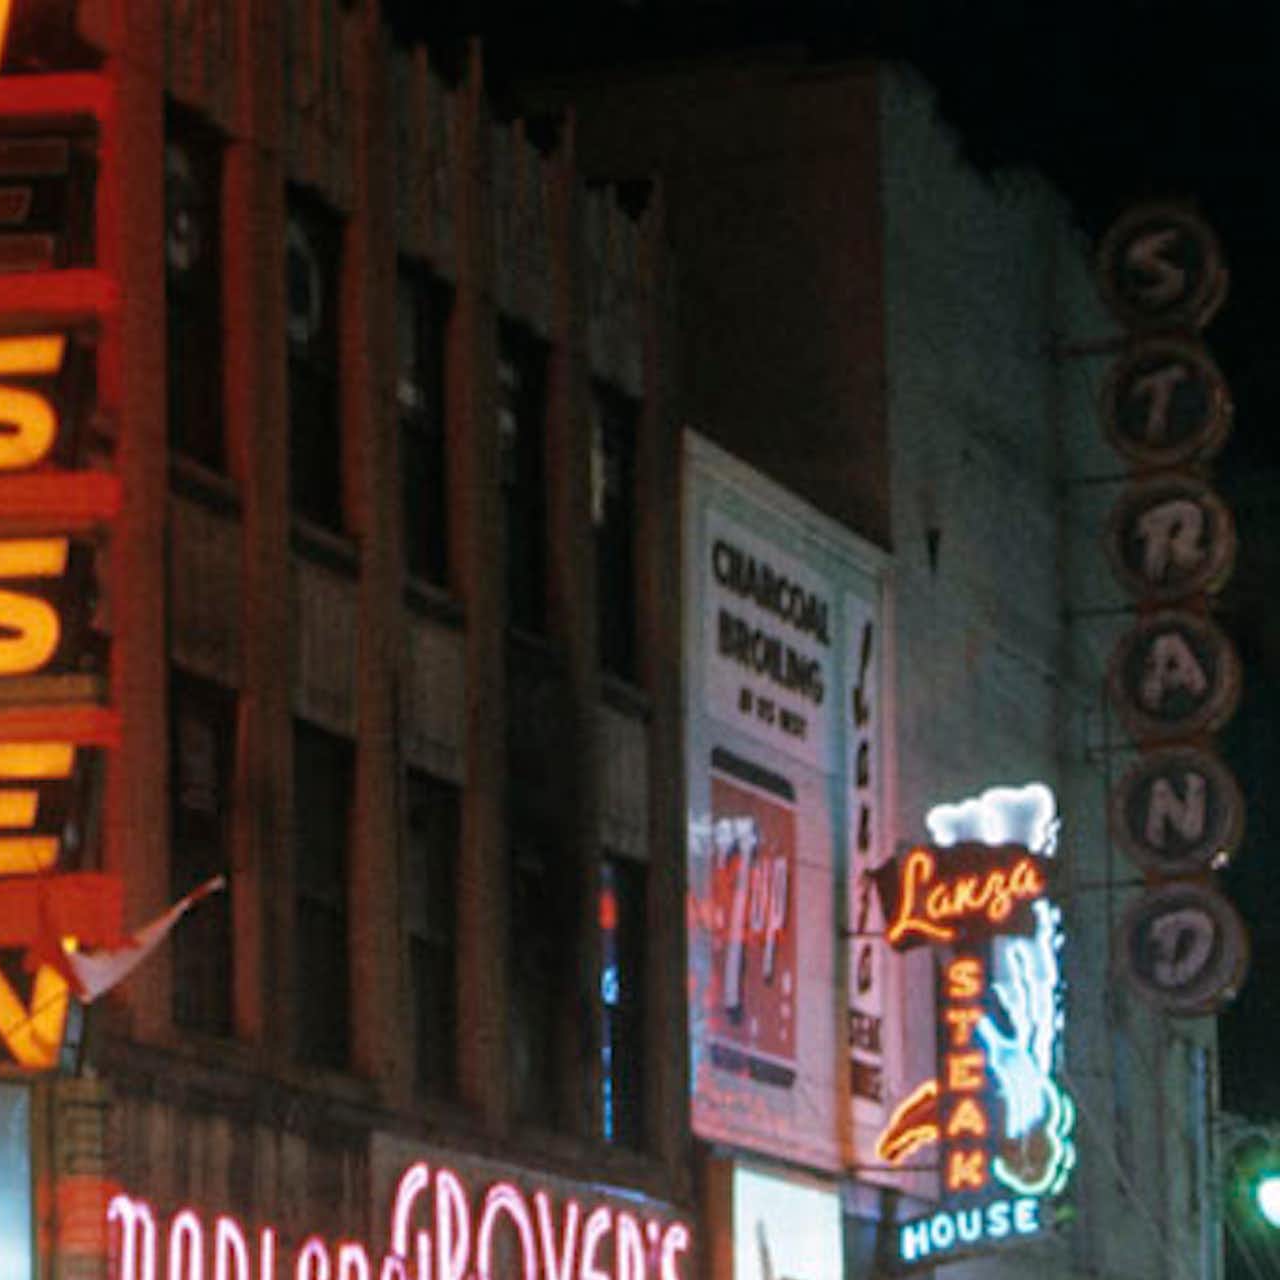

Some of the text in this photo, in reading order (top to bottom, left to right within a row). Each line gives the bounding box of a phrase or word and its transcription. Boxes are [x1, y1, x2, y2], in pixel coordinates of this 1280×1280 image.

[1126, 226, 1218, 988] STRAND
[887, 848, 1043, 940] Lanza
[946, 958, 987, 1190] STEAK
[900, 1201, 1041, 1260] HOUSE
